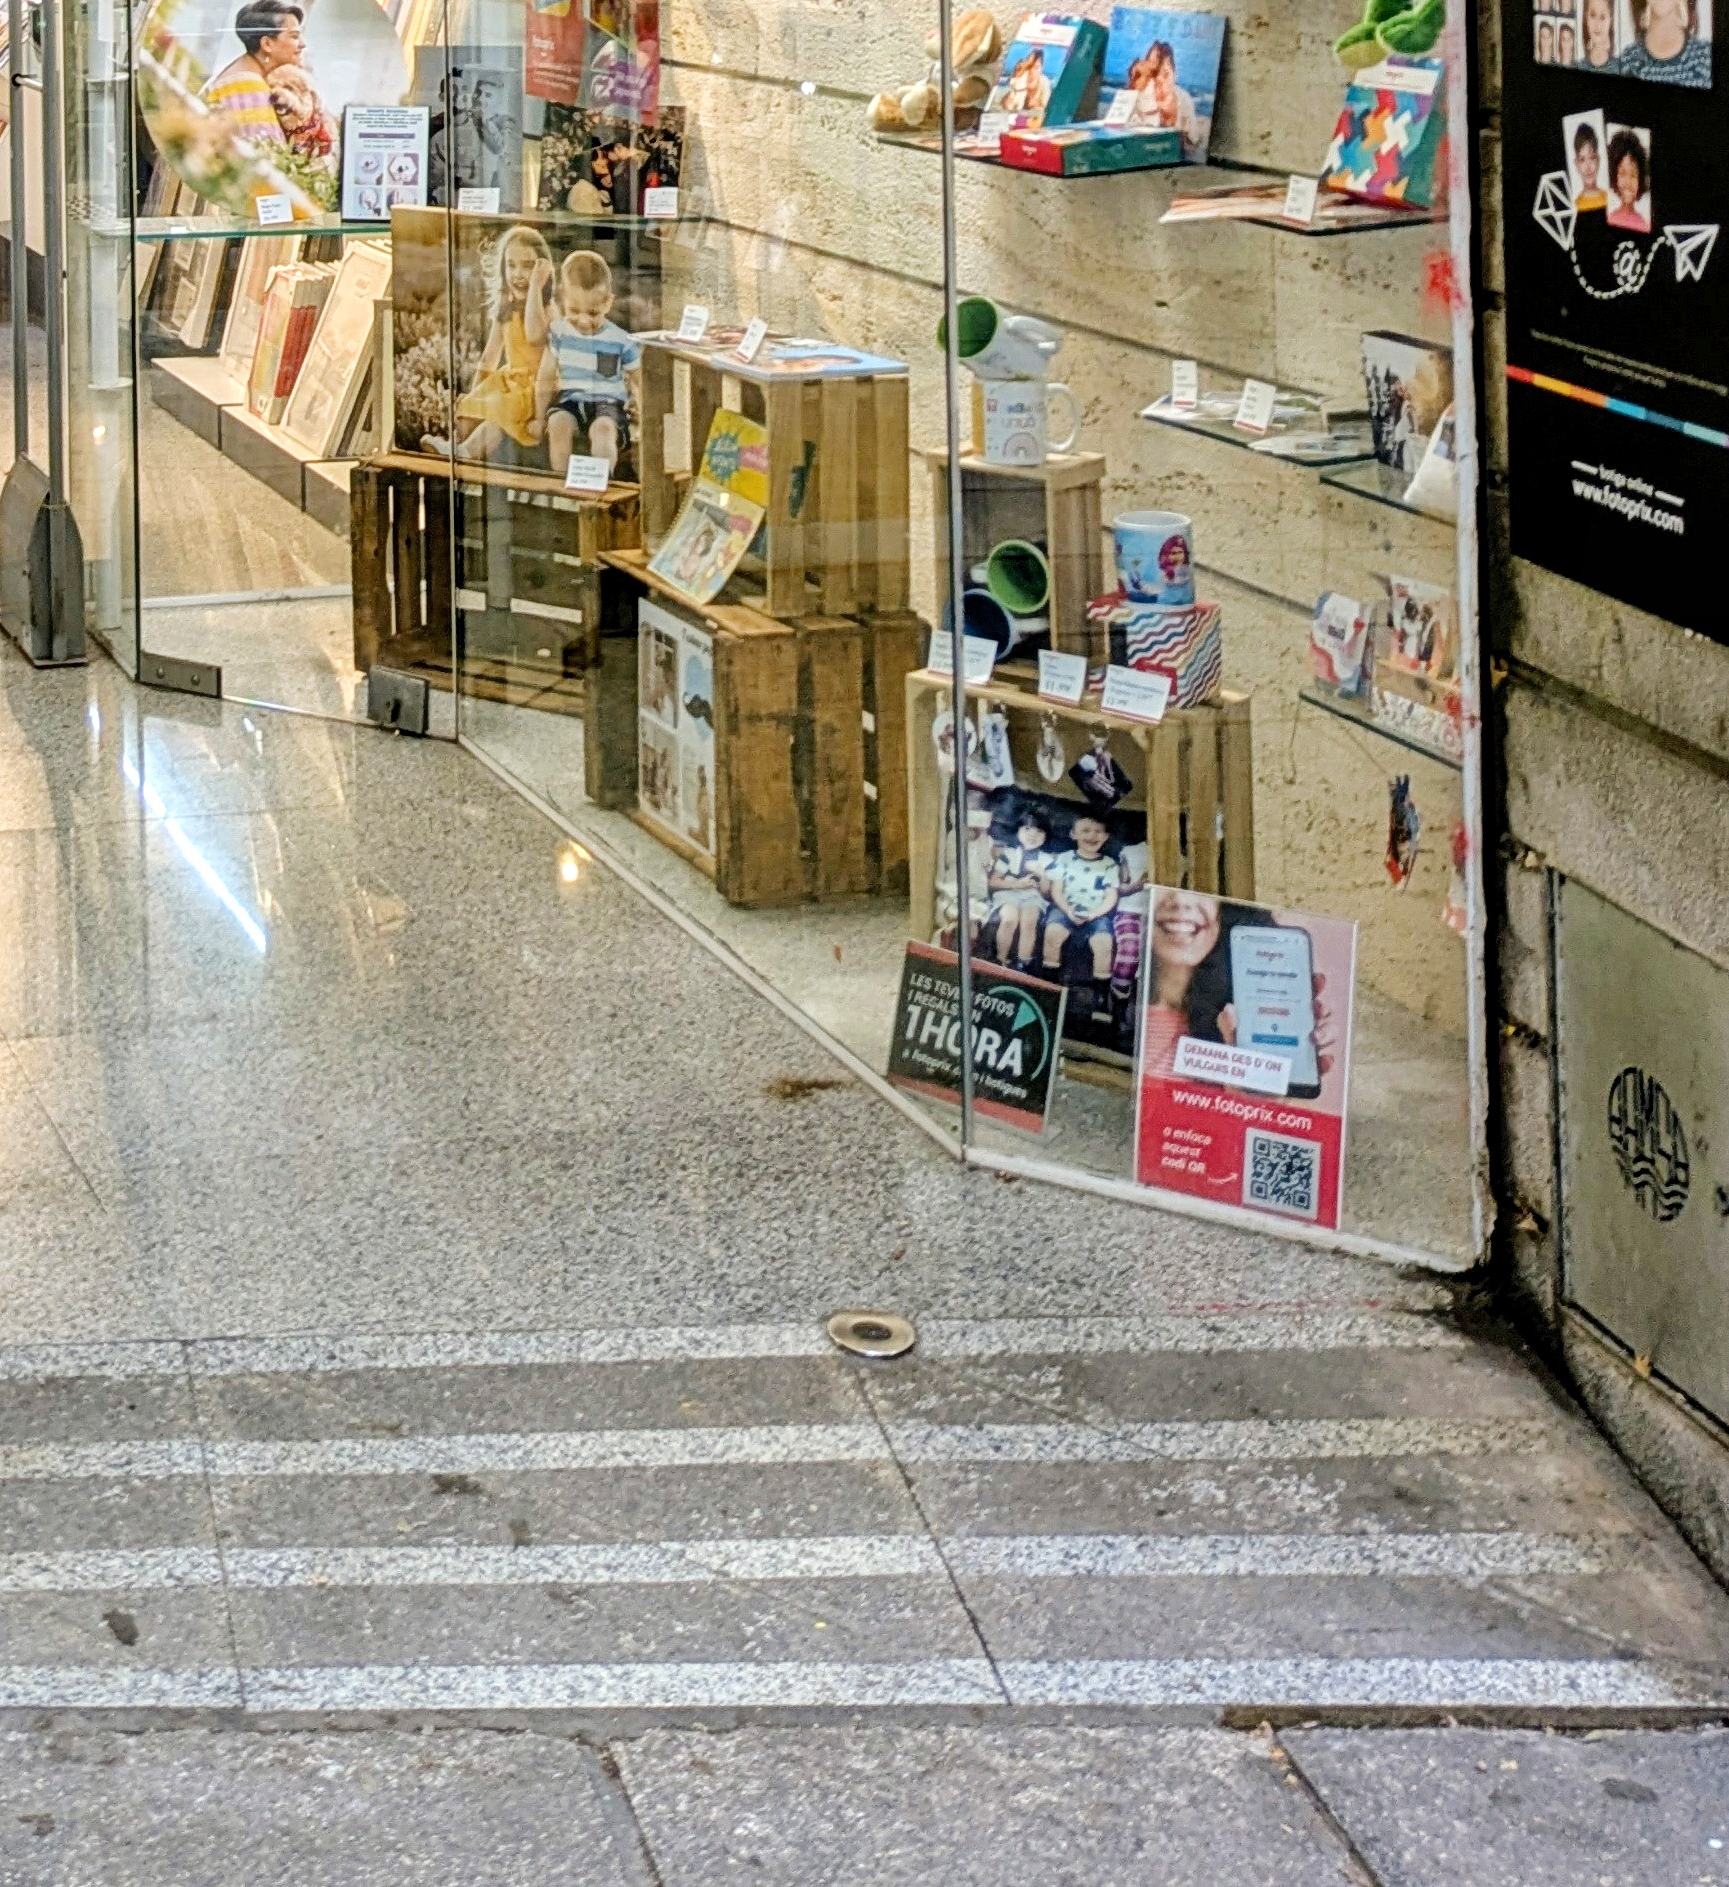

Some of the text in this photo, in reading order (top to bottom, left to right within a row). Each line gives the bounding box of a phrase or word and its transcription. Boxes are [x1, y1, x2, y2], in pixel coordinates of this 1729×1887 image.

[910, 973, 933, 991] LES
[975, 993, 1016, 1018] FOTOS
[1184, 1043, 1229, 1061] DEMANA
[1173, 1089, 1313, 1131] www.fotoprix.com
